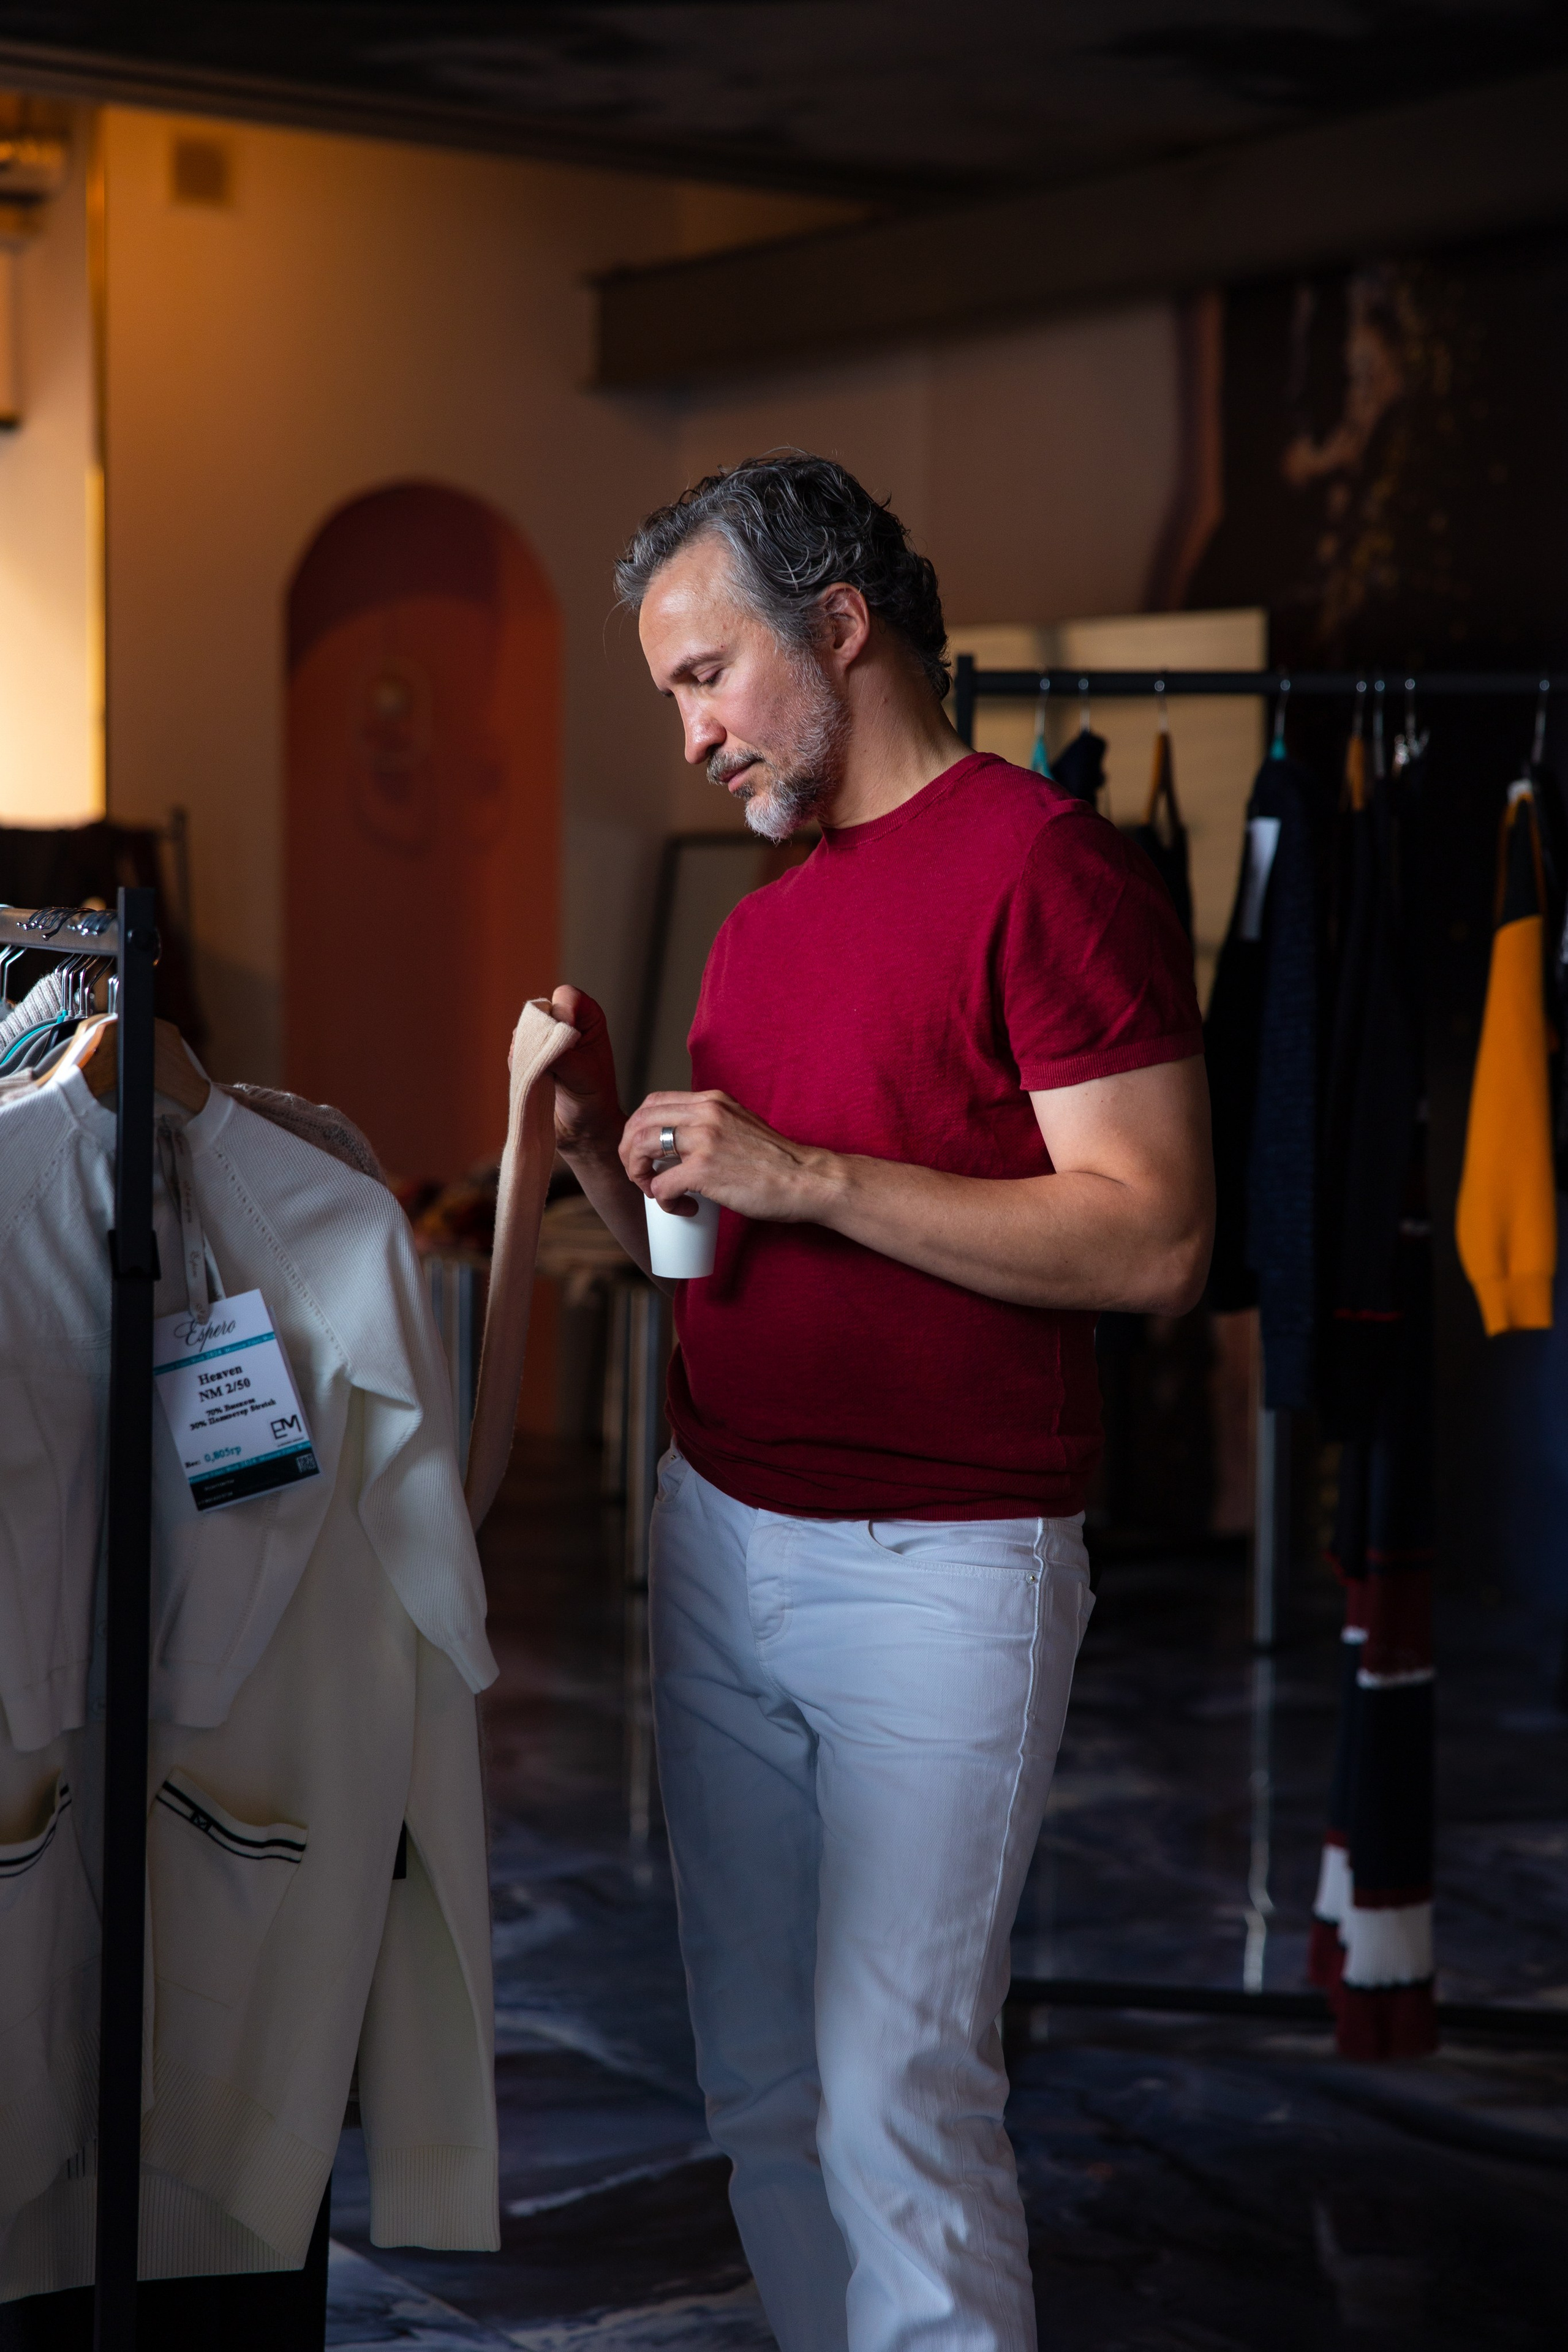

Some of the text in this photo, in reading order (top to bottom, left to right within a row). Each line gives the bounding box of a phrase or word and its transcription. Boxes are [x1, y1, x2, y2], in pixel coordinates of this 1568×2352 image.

[174, 1318, 236, 1352] Espero
[198, 1365, 243, 1385] Heaven
[198, 1378, 251, 1403] NM 2/50
